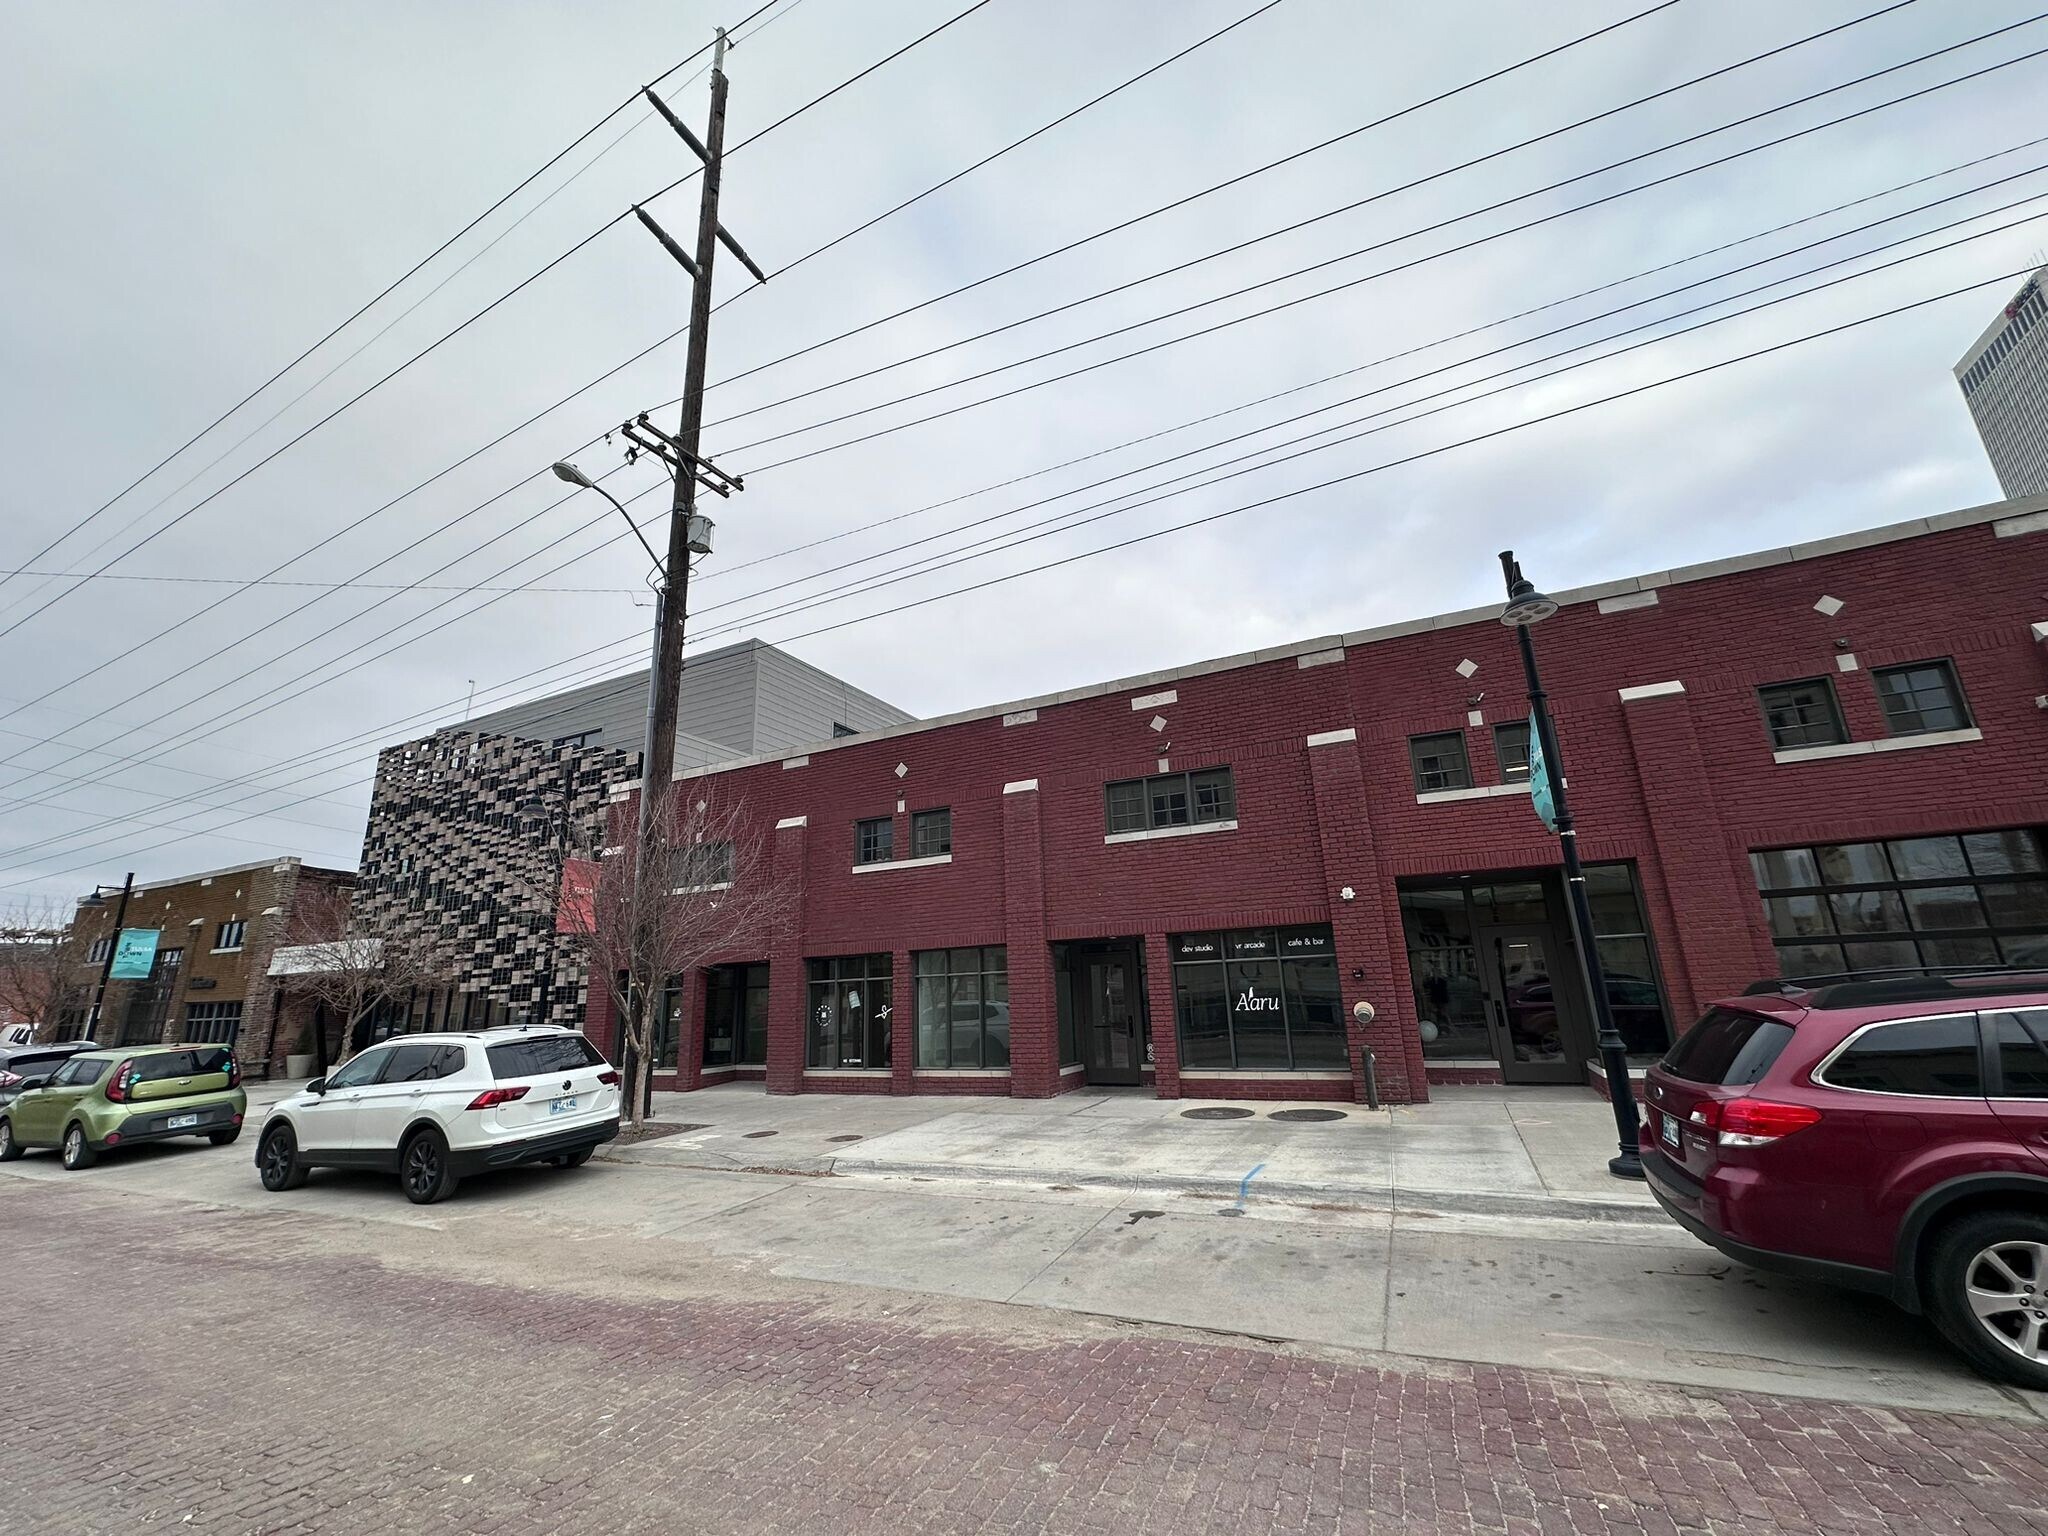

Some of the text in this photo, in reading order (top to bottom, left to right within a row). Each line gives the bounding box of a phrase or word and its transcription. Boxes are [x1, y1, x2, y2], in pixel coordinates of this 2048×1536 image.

[1243, 940, 1266, 949] arcade
[1287, 937, 1325, 947] cafe & bar
[1181, 943, 1214, 953] dev studio
[1235, 988, 1280, 1012] Aaru
